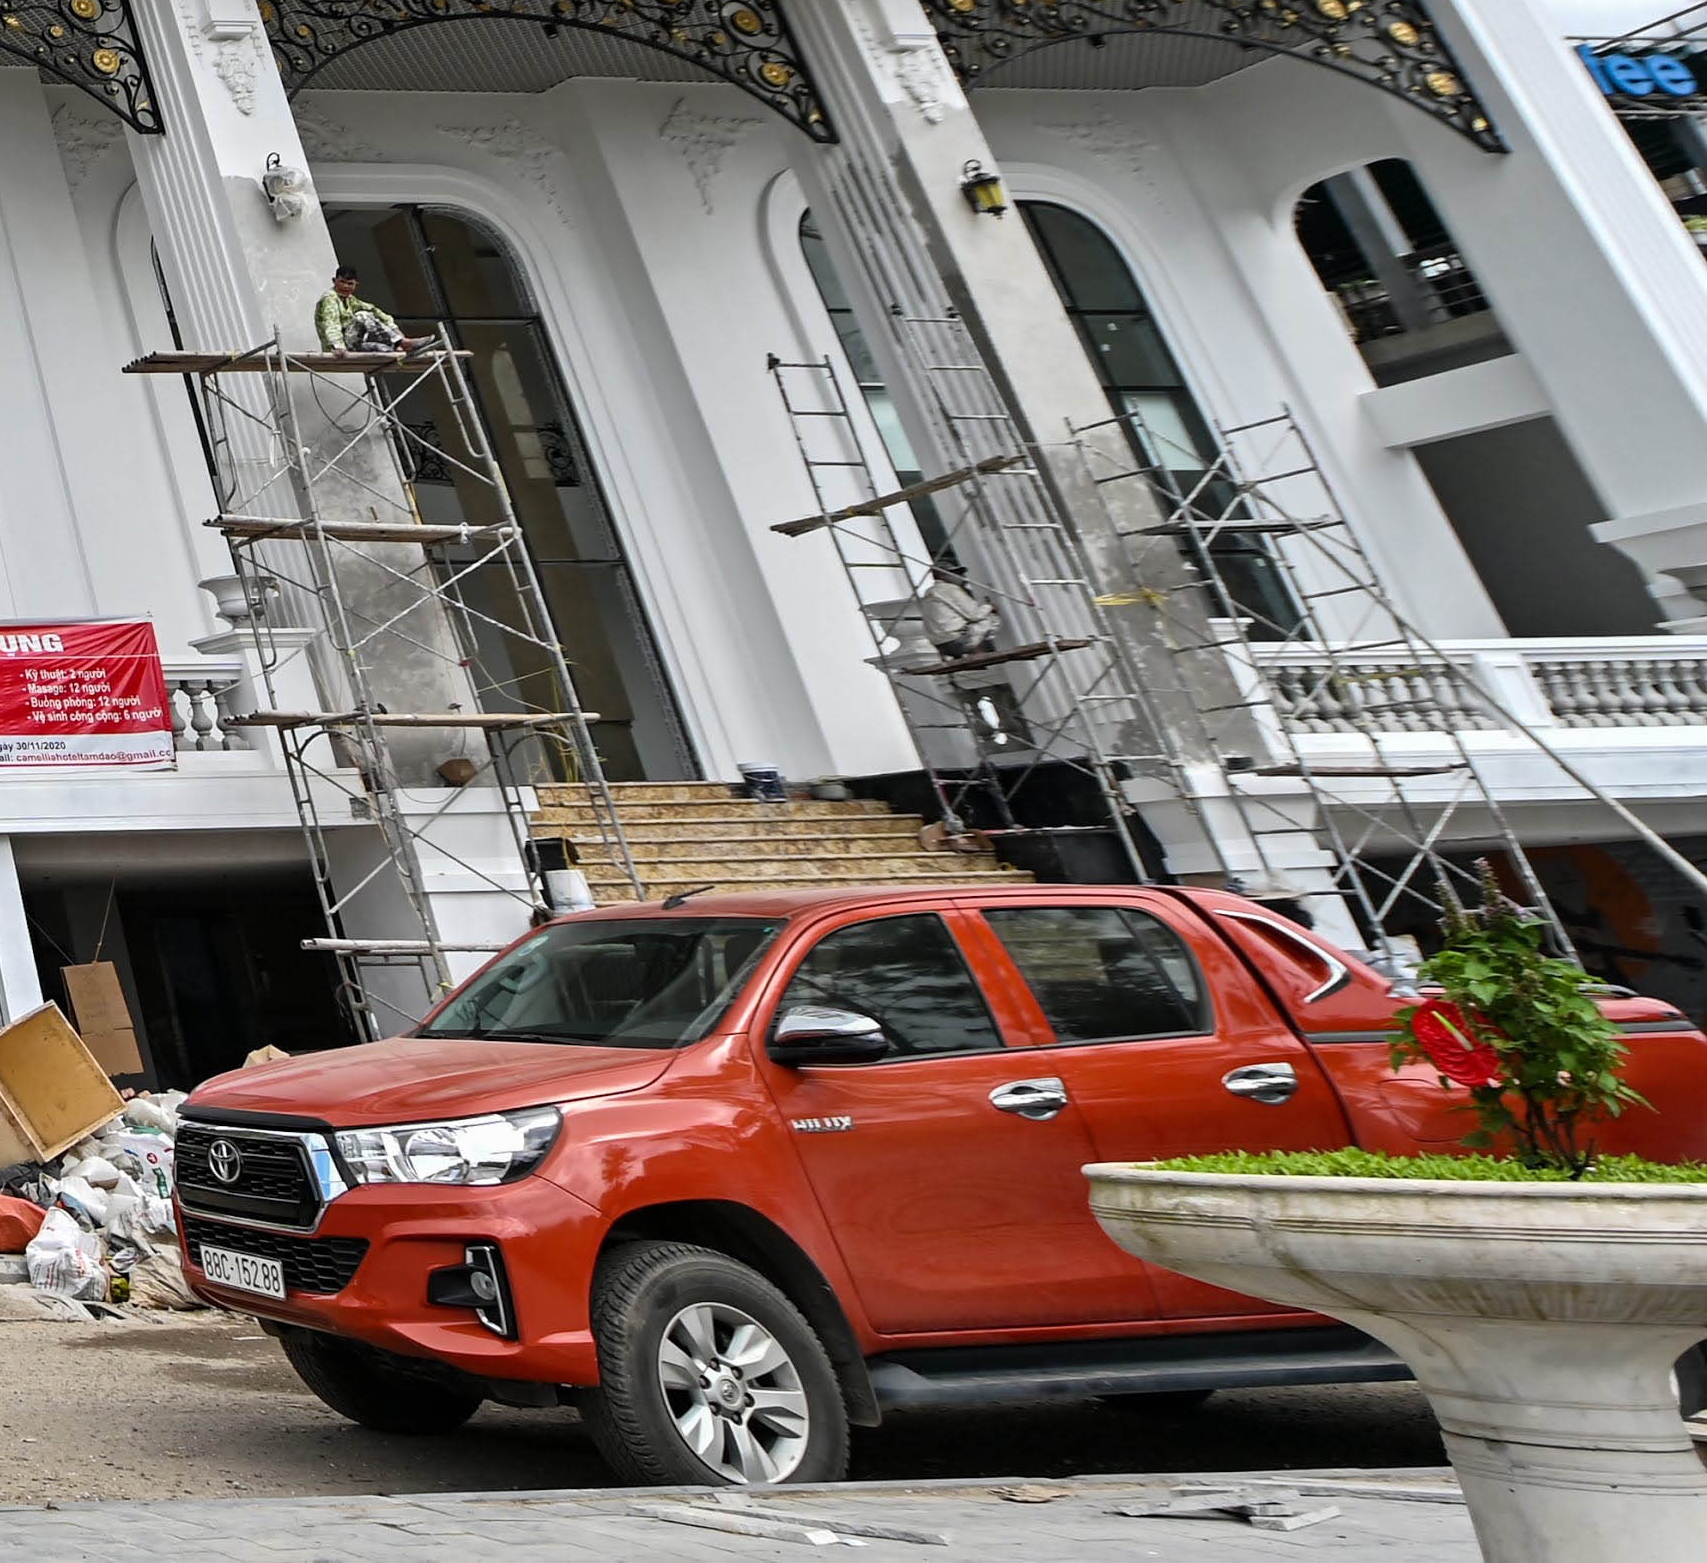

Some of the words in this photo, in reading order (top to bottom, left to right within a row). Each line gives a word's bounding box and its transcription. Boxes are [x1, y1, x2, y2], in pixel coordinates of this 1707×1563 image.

[70, 670, 76, 679] 2
[78, 669, 106, 681] người
[69, 683, 80, 693] 12
[82, 683, 111, 695] người
[63, 696, 96, 709] phòng:
[98, 697, 110, 706] 12
[112, 695, 140, 708] người
[47, 711, 67, 722] sinh
[69, 711, 93, 723] công
[95, 711, 122, 722] cộng:
[124, 710, 130, 719] 6
[16, 741, 66, 750] 30/11/2020
[791, 1116, 854, 1131] HILUX
